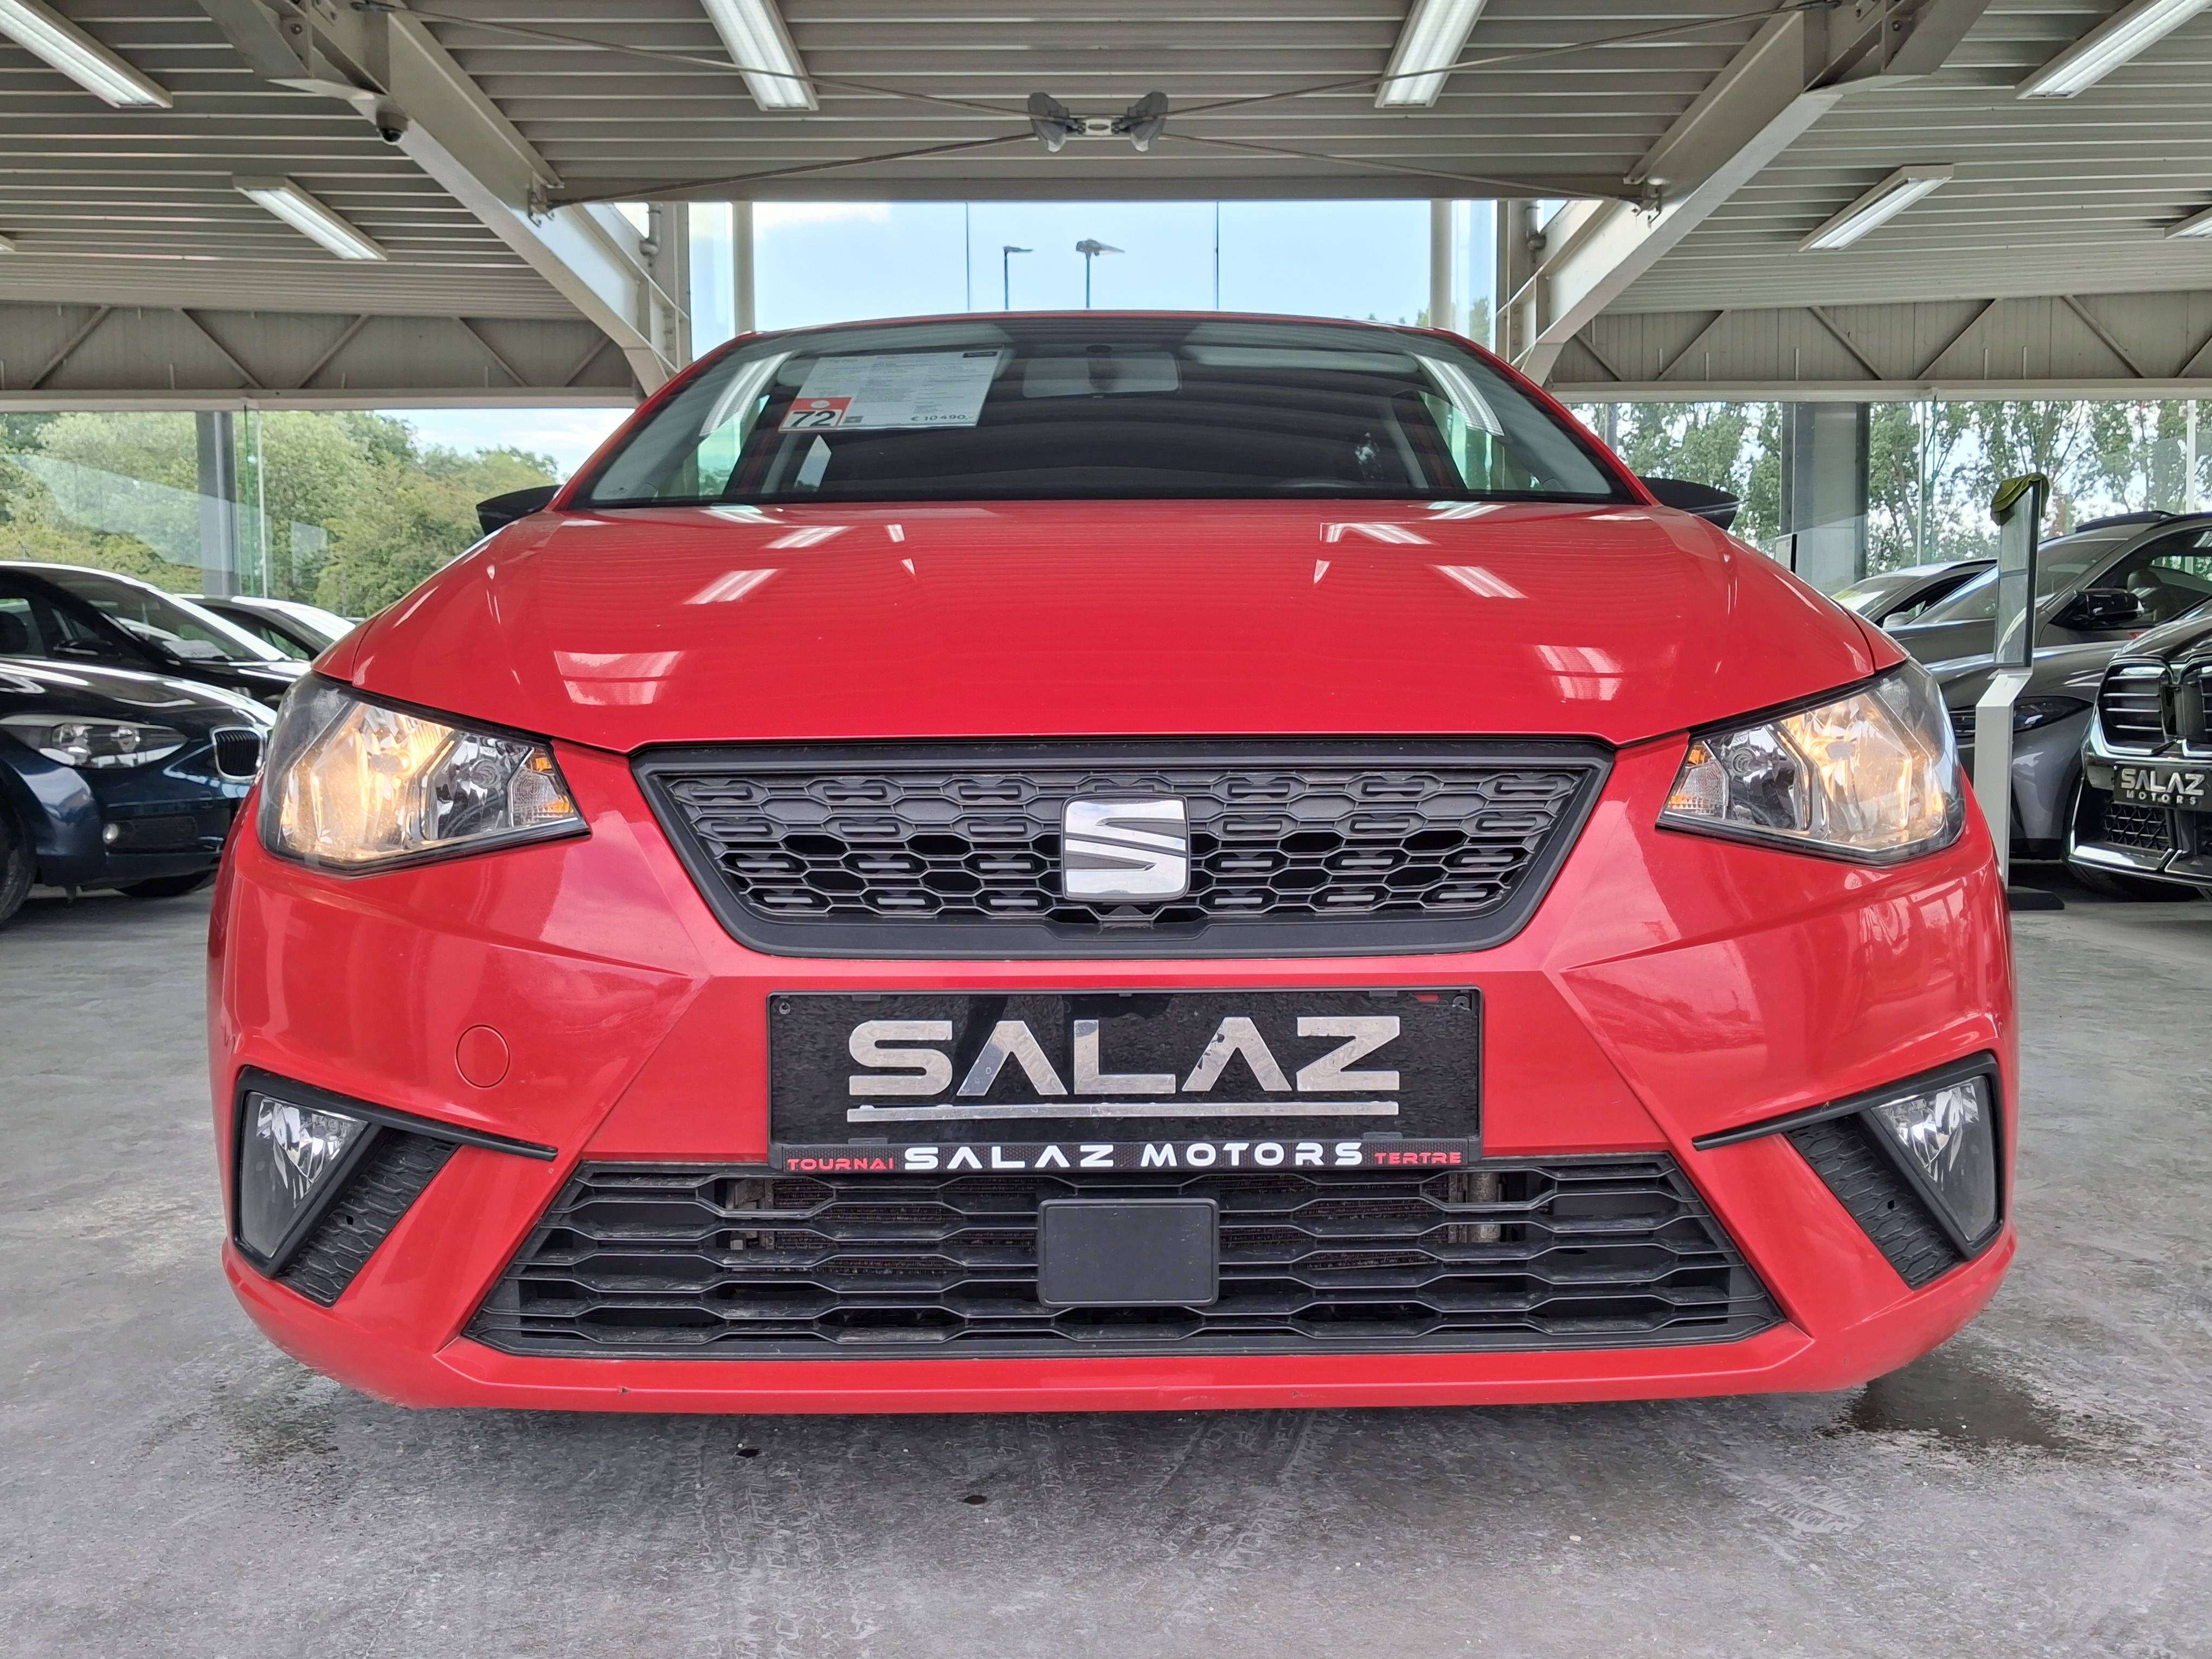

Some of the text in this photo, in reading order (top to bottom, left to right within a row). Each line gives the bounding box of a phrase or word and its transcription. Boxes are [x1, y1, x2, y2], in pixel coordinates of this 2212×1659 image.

[790, 410, 836, 427] 72
[2121, 769, 2204, 795] SALAZ
[2126, 789, 2197, 805] MOTORS
[848, 1016, 1400, 1096] SALAZ
[788, 1142, 1462, 1171] TOURNAI SALAZ MOTORS TERTRE
